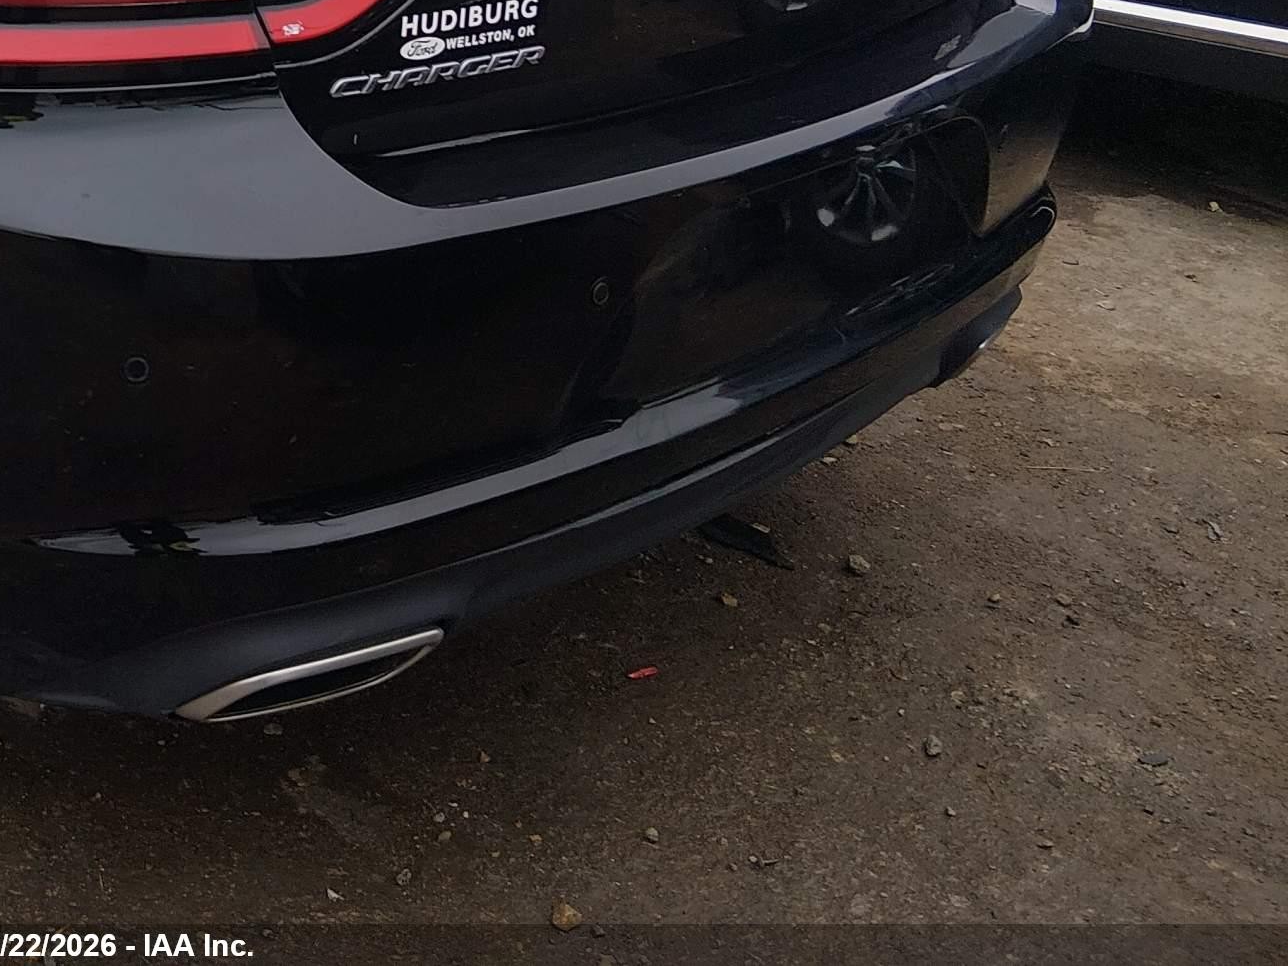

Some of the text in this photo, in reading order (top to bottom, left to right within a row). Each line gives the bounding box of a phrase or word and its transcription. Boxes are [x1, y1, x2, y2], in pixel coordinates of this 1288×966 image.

[404, 24, 536, 58] Ford WELLSTON, OK
[329, 45, 545, 98] CHARGER
